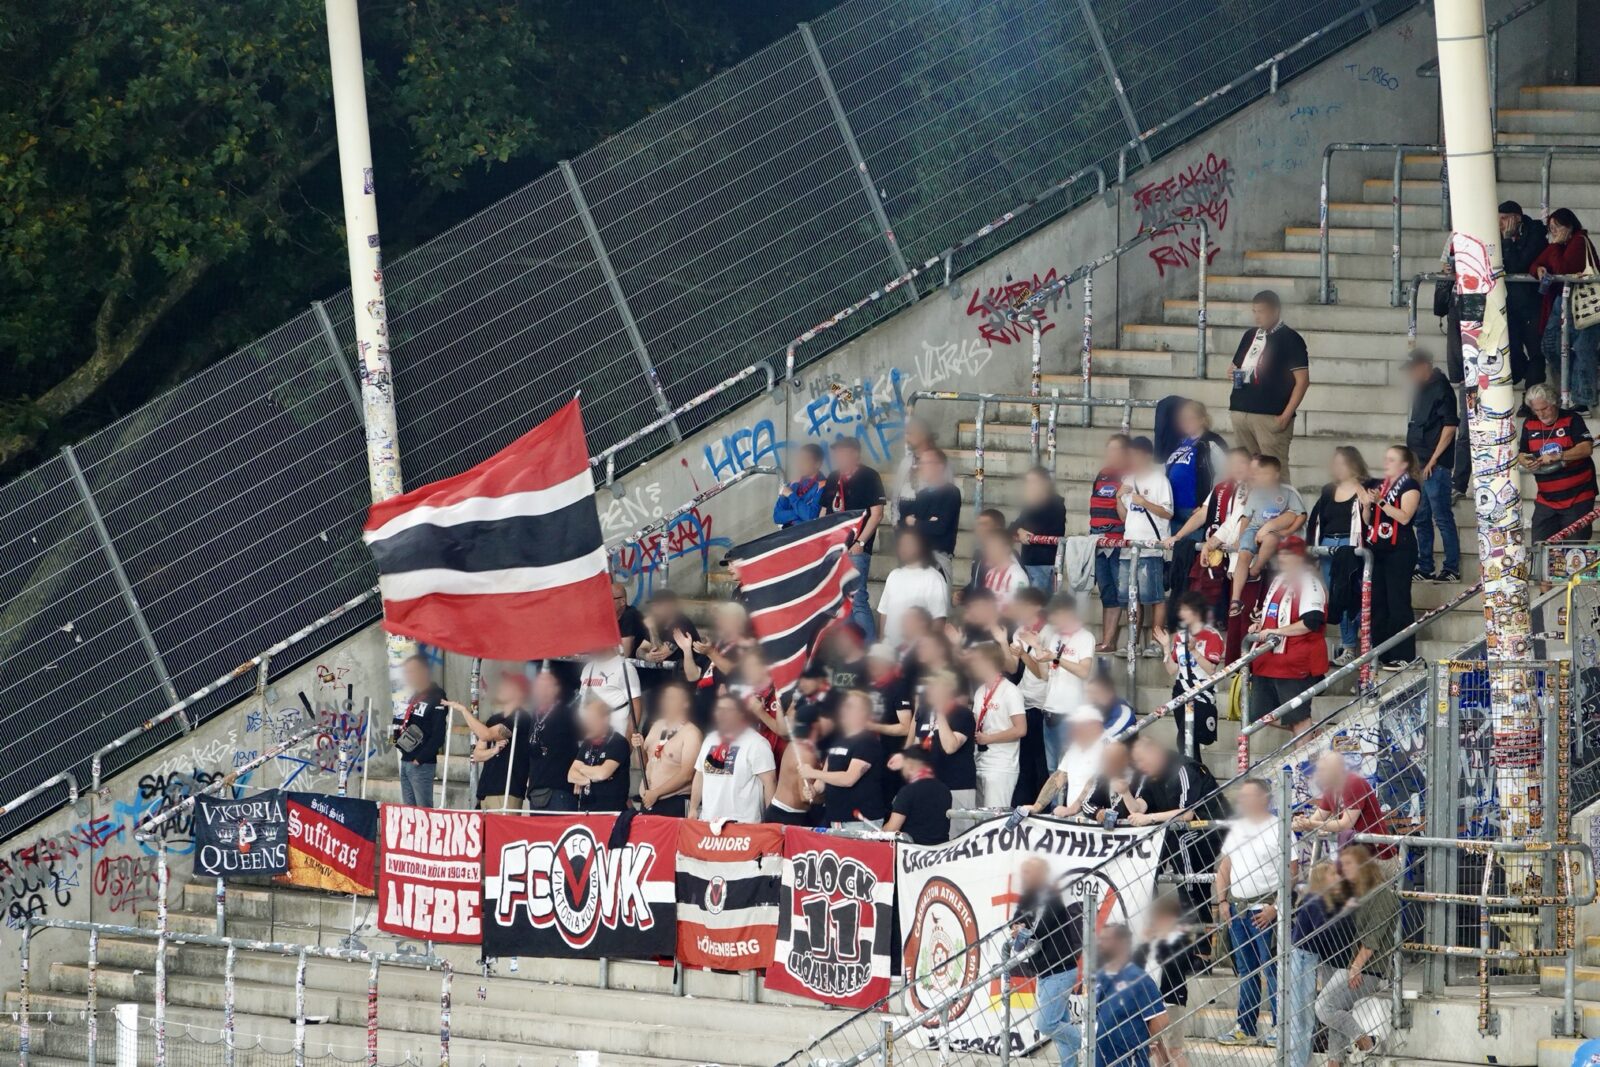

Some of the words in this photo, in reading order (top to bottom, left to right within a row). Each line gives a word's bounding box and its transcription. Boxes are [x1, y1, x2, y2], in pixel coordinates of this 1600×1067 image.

[915, 339, 993, 388] ULTRAS
[201, 801, 285, 826] VIKTORIA
[385, 806, 482, 858] VEREINS
[201, 843, 287, 876] QUEENS
[572, 838, 586, 854] FC
[697, 836, 752, 851] JUNIORS
[1036, 828, 1153, 860] ATHLETIC
[427, 863, 446, 879] KÖLN
[792, 850, 877, 902] BLOCK
[384, 880, 481, 935] LIEBE
[554, 870, 580, 930] VIKTORIA
[940, 886, 972, 928] ATHLETIC
[697, 936, 761, 958] HÖHENBERG
[801, 895, 861, 962] 11
[789, 950, 873, 994] HÖHENBERG
